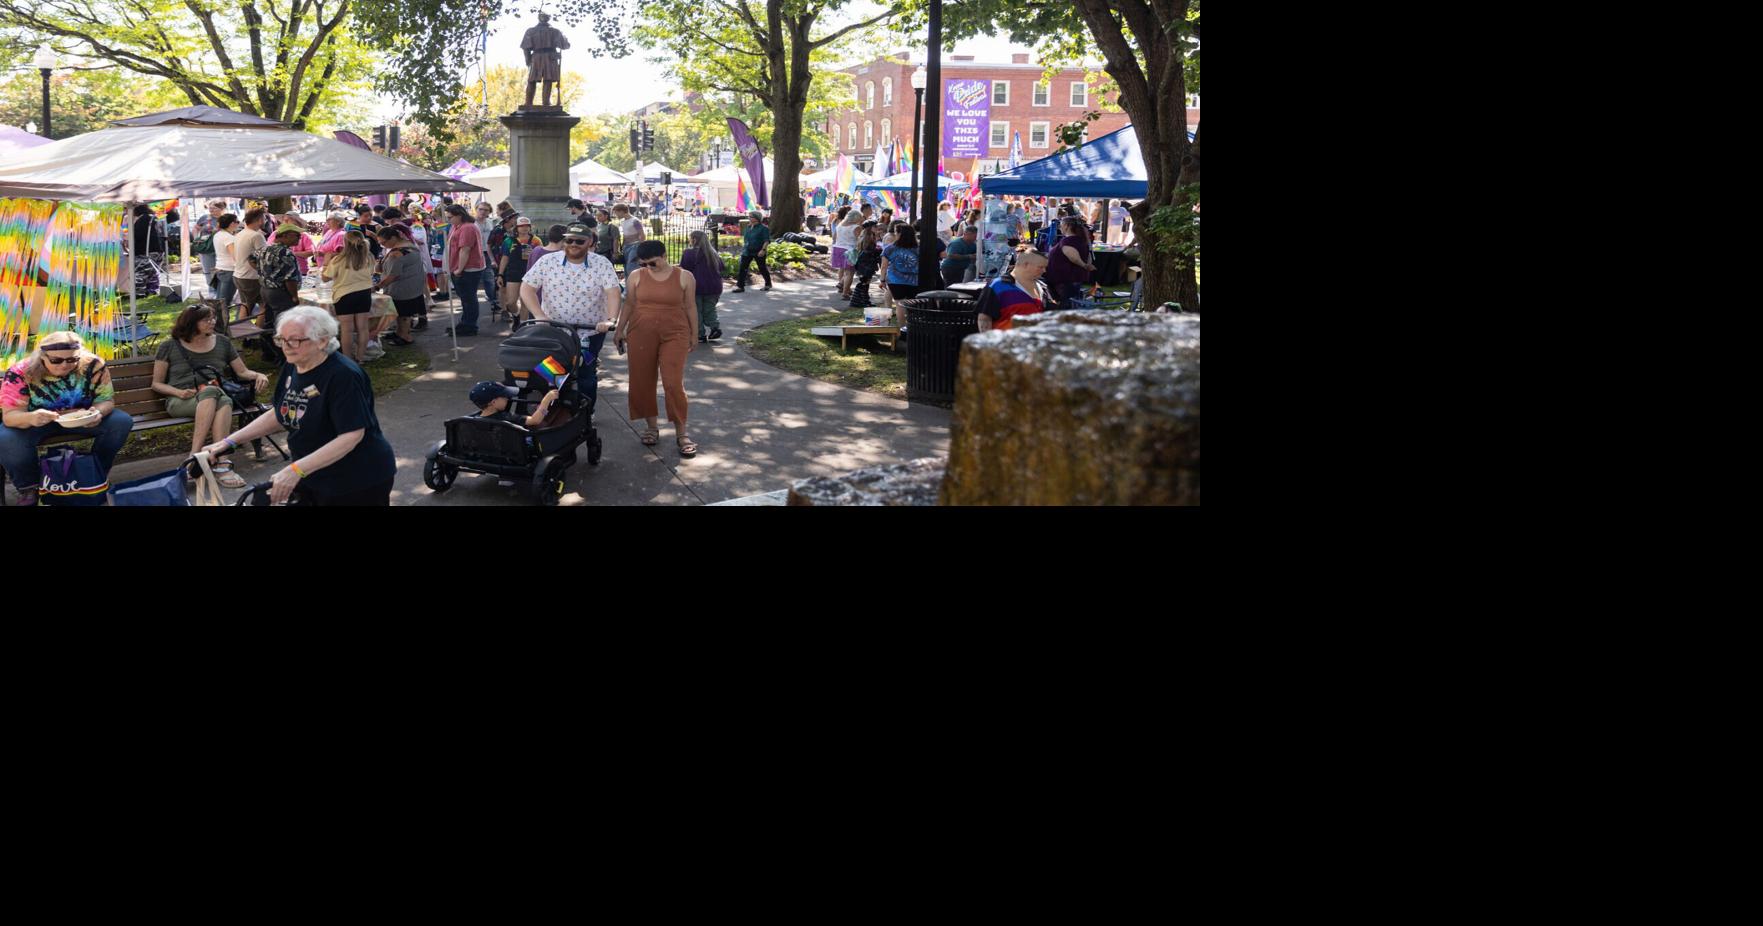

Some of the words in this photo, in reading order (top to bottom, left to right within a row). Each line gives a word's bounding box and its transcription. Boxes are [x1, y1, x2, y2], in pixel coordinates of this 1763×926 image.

[953, 81, 983, 102] Pride
[946, 109, 961, 117] WE
[962, 109, 987, 117] LOVE
[40, 475, 79, 493] love
